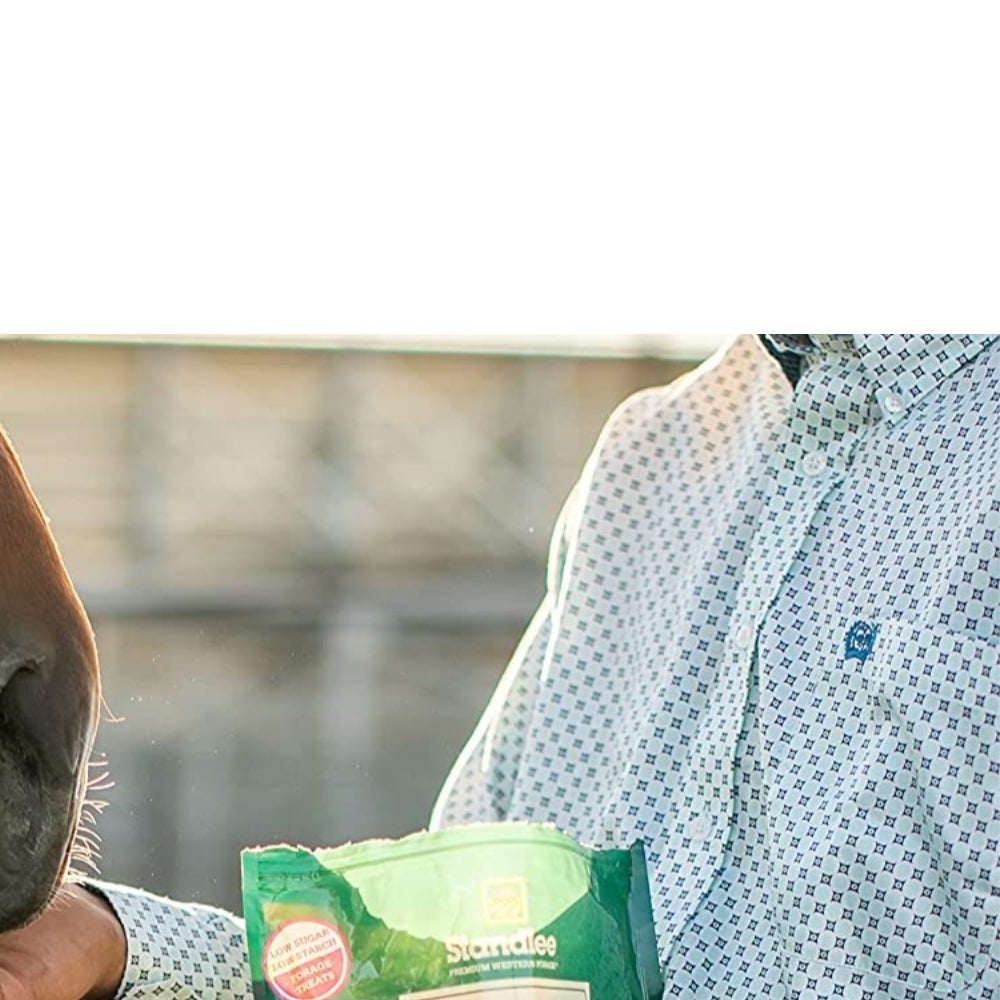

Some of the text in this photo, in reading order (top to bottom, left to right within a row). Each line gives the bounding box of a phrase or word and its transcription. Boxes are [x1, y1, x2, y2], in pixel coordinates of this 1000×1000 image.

[270, 929, 330, 958] LOW SUGAR
[271, 938, 337, 972] LOW STARCH
[445, 928, 557, 963] Standlee
[289, 959, 333, 984] FORAGE
[295, 971, 336, 993] TREATS
